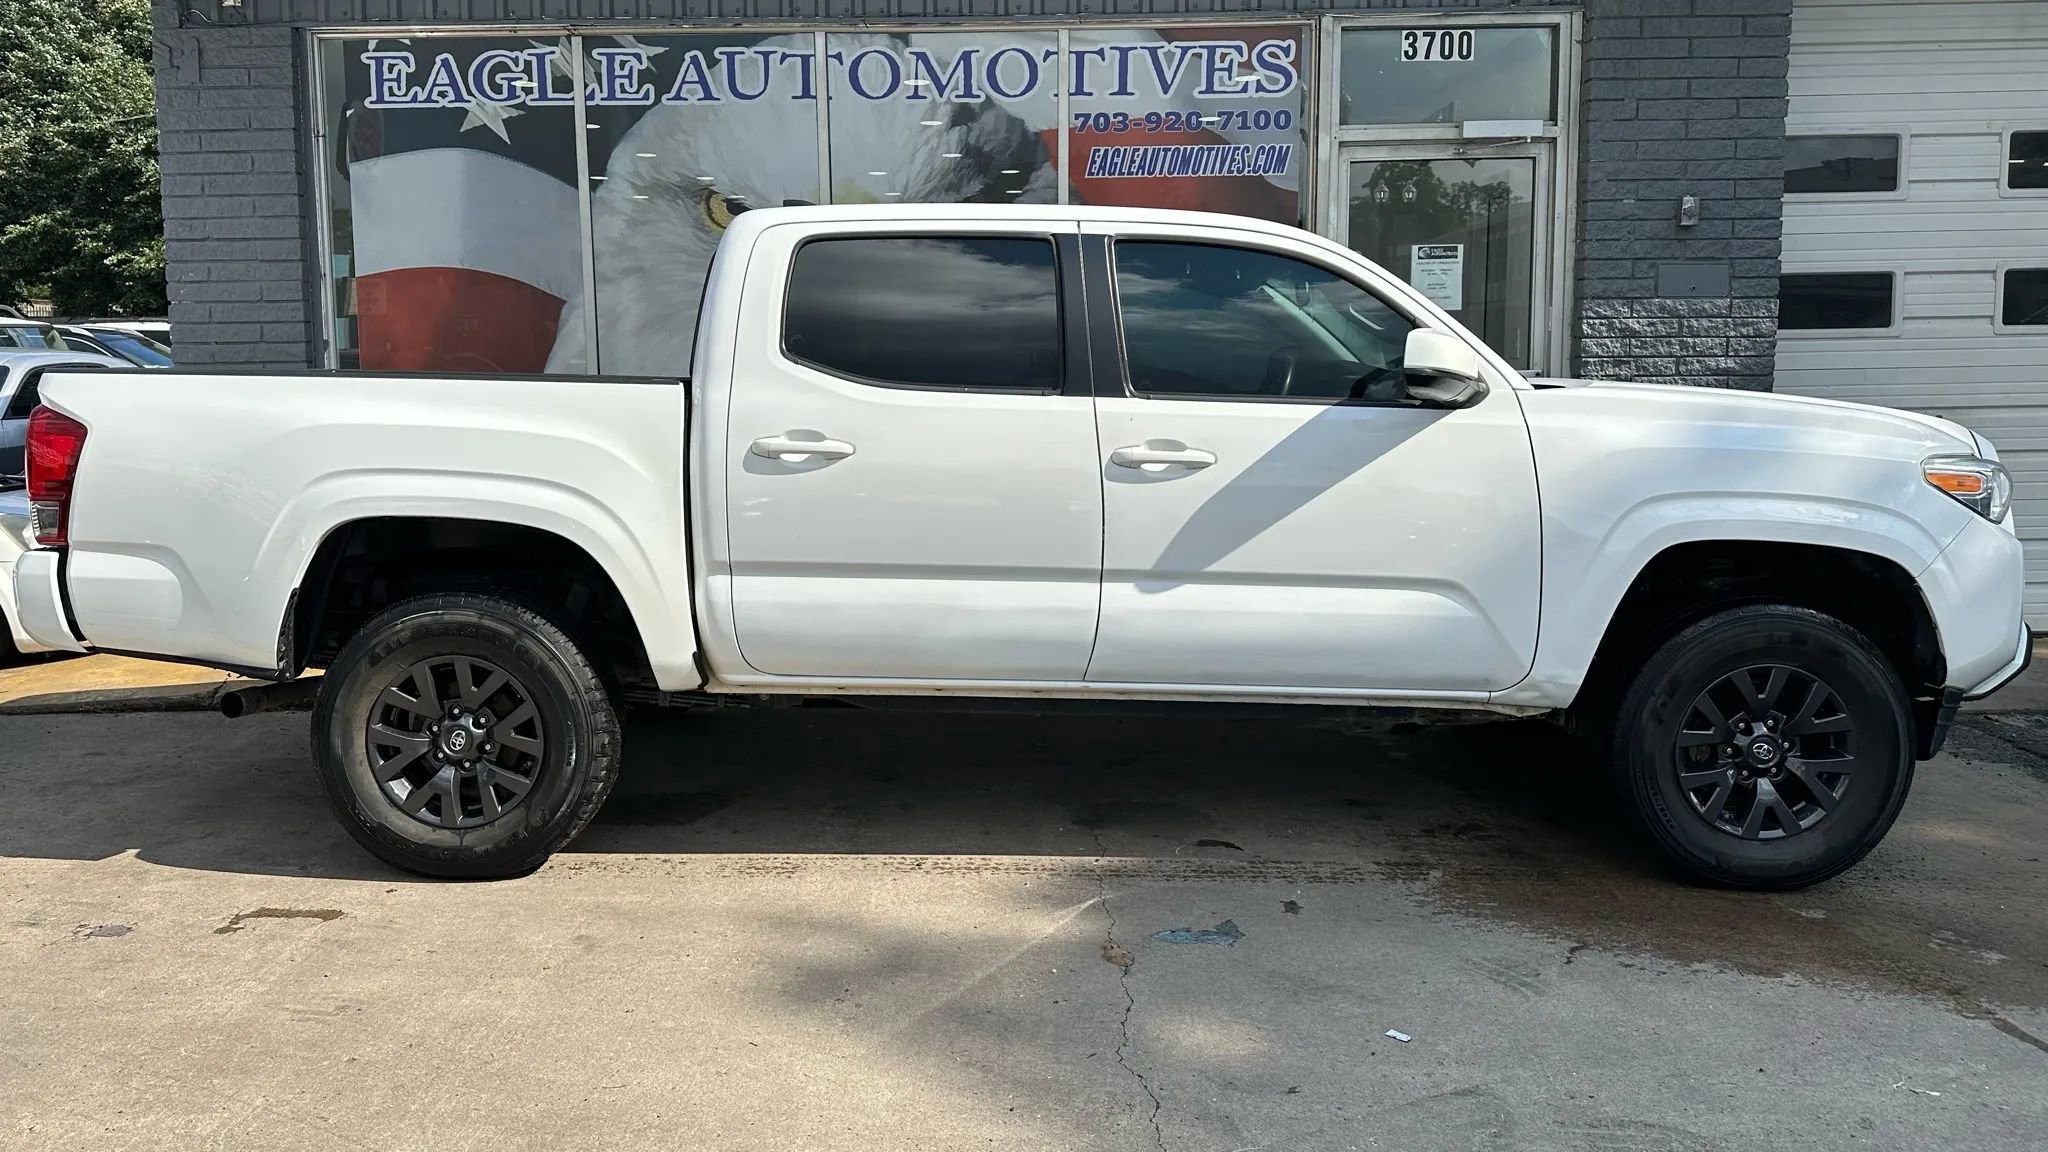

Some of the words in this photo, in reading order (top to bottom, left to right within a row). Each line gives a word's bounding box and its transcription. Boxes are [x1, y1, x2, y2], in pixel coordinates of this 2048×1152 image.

[1403, 30, 1473, 61] 3700
[362, 49, 654, 107] EAGLE
[662, 39, 1298, 105] AUTOMOTIVES
[1073, 109, 1293, 133] 703-920-7100
[1085, 144, 1293, 178] EAGLEAUTOMOTIVES.COM
